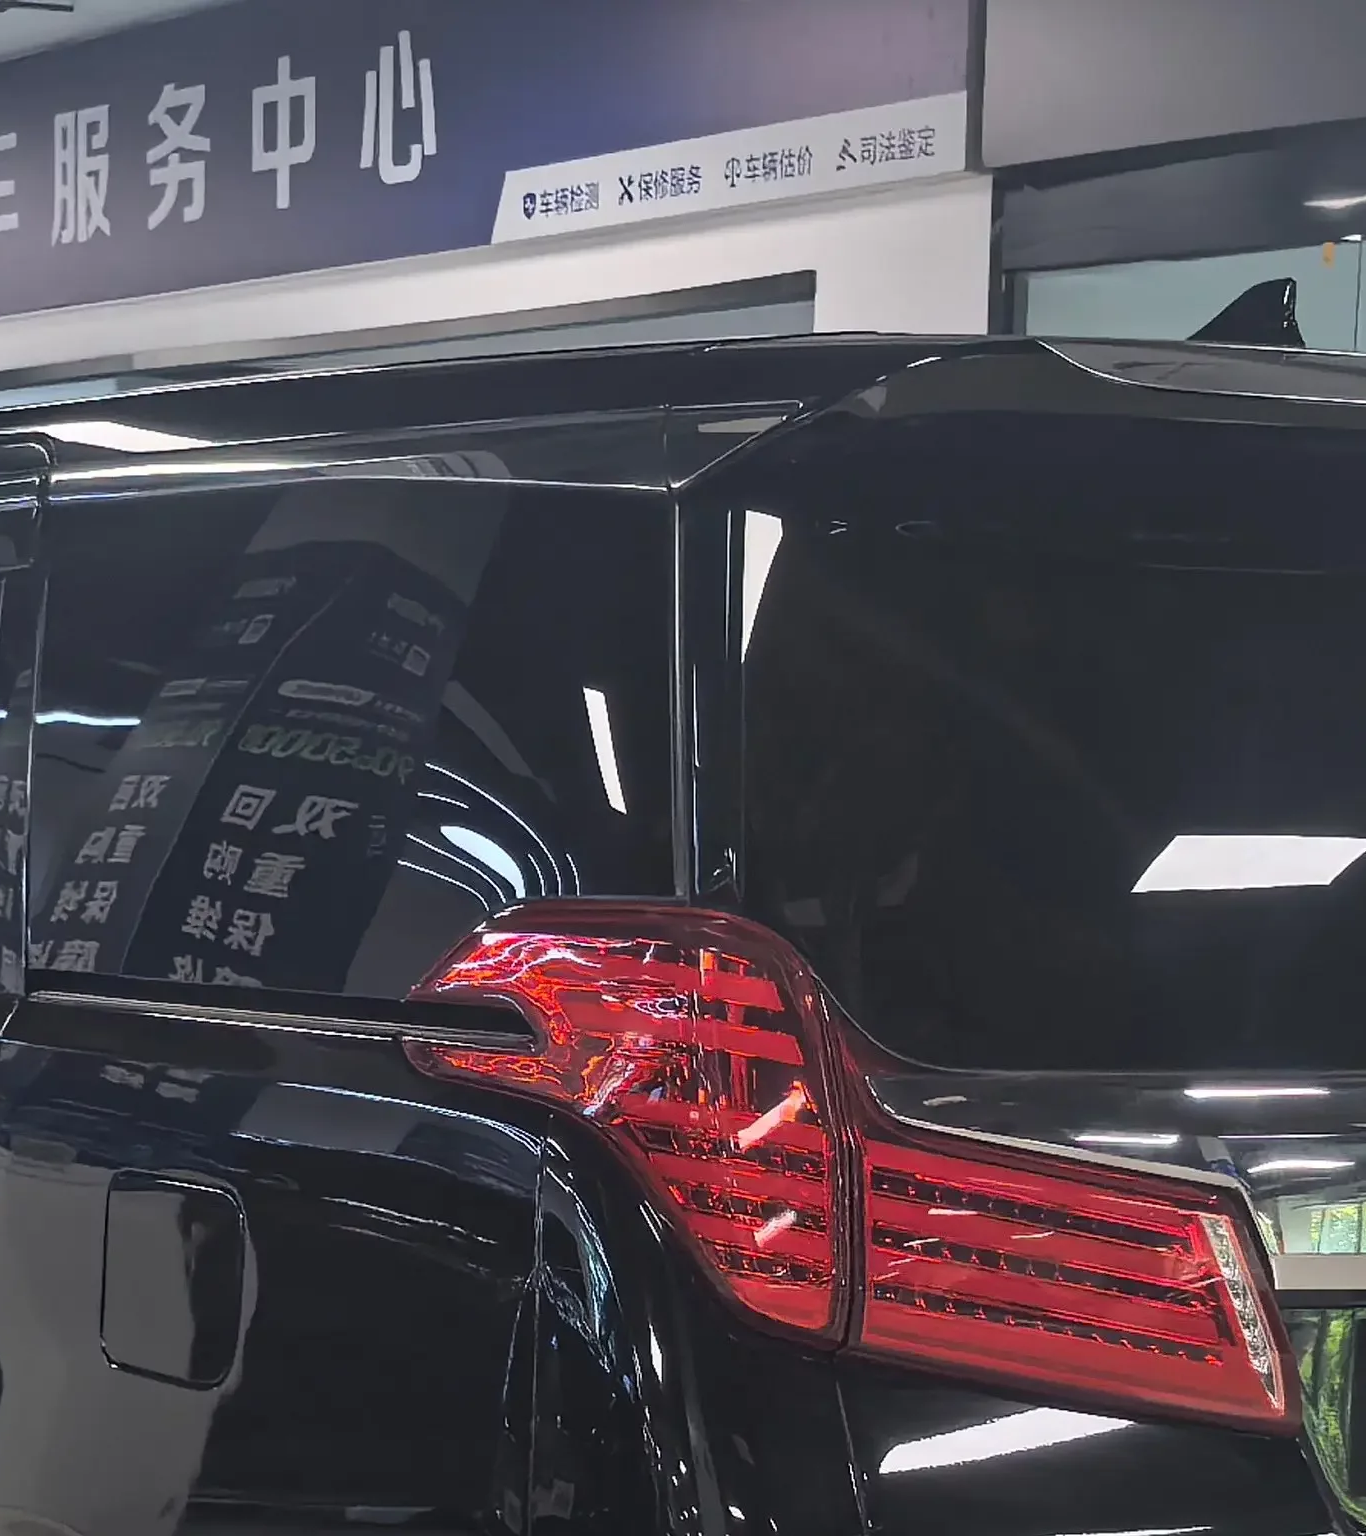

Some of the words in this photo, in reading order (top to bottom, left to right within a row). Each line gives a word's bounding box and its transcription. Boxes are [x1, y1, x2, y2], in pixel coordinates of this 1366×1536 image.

[744, 145, 813, 182] 车辆估价
[860, 126, 935, 165] 司法鉴定
[638, 164, 703, 200] 保修服务
